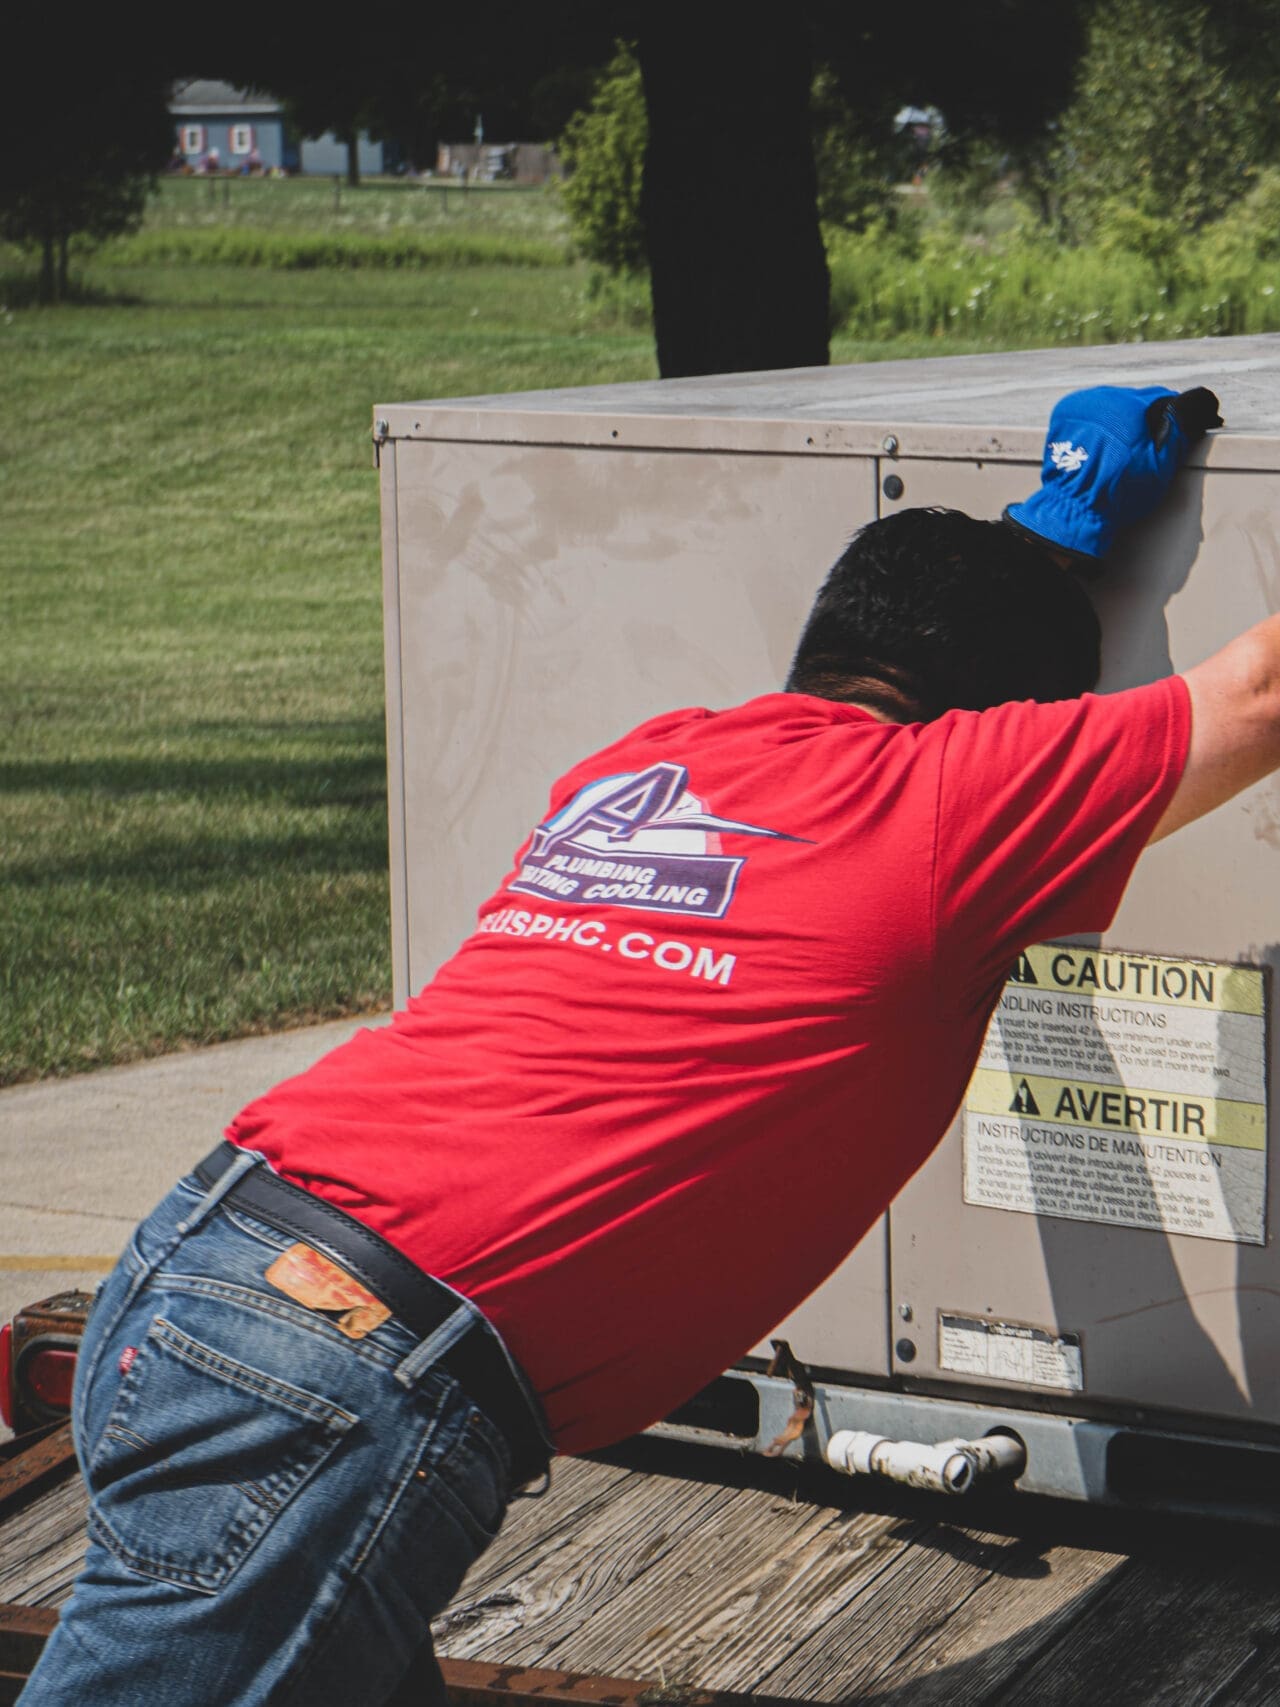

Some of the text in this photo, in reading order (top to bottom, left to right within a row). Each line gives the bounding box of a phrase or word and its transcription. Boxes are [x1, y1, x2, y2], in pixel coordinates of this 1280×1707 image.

[544, 855, 656, 884] PLUMBING
[582, 883, 709, 906] COOLING
[1051, 953, 1215, 1003] CAUTION
[1000, 995, 1167, 1029] NDLING INSTRUCTIONS
[1028, 1020, 1039, 1029] be
[1042, 1021, 1077, 1035] inserted
[1051, 1045, 1068, 1056] and
[1212, 1066, 1230, 1077] two
[1053, 1058, 1074, 1070] from
[1054, 1086, 1206, 1137] AVERTIR
[977, 1120, 1223, 1169] INSTRUCTIONS DE MANUTENTION
